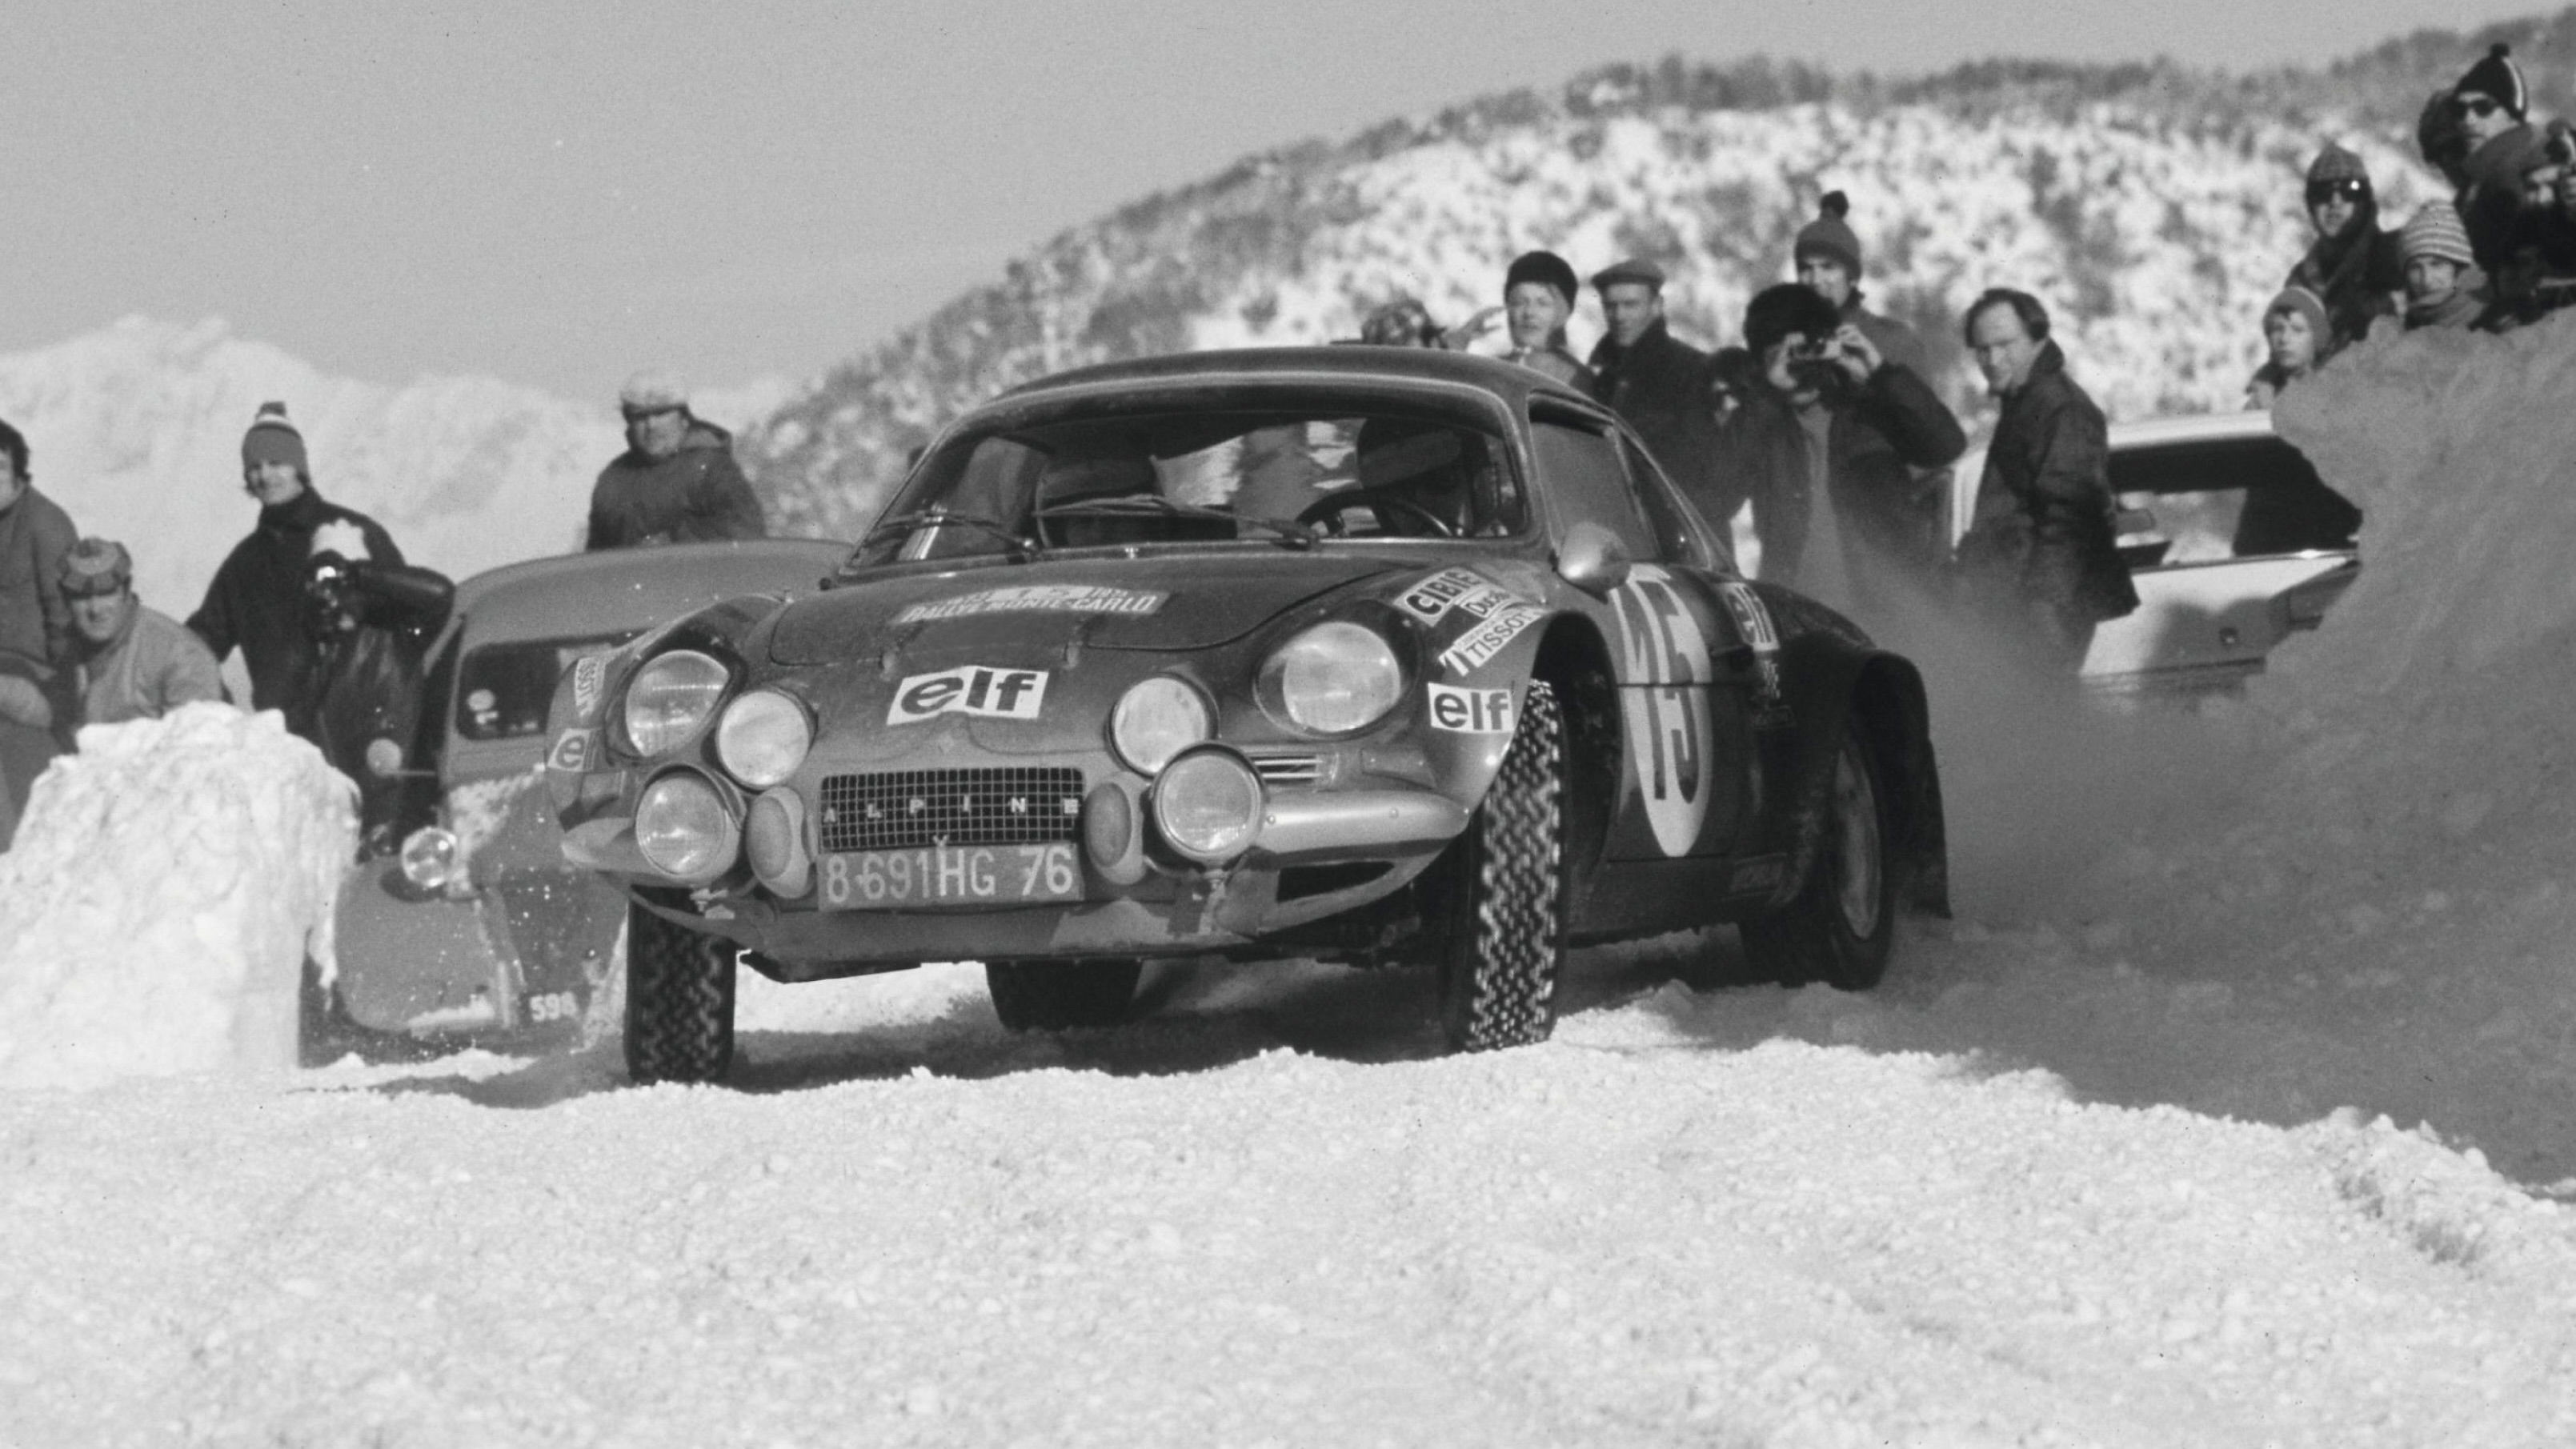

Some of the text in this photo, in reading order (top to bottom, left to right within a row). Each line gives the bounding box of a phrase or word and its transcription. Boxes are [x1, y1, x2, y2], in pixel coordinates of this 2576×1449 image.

[1406, 570, 1482, 616] CIBIE
[900, 669, 1037, 714] elf
[1434, 691, 1509, 731] elf
[823, 798, 1079, 823] ALPINE
[1020, 846, 1074, 896] 76
